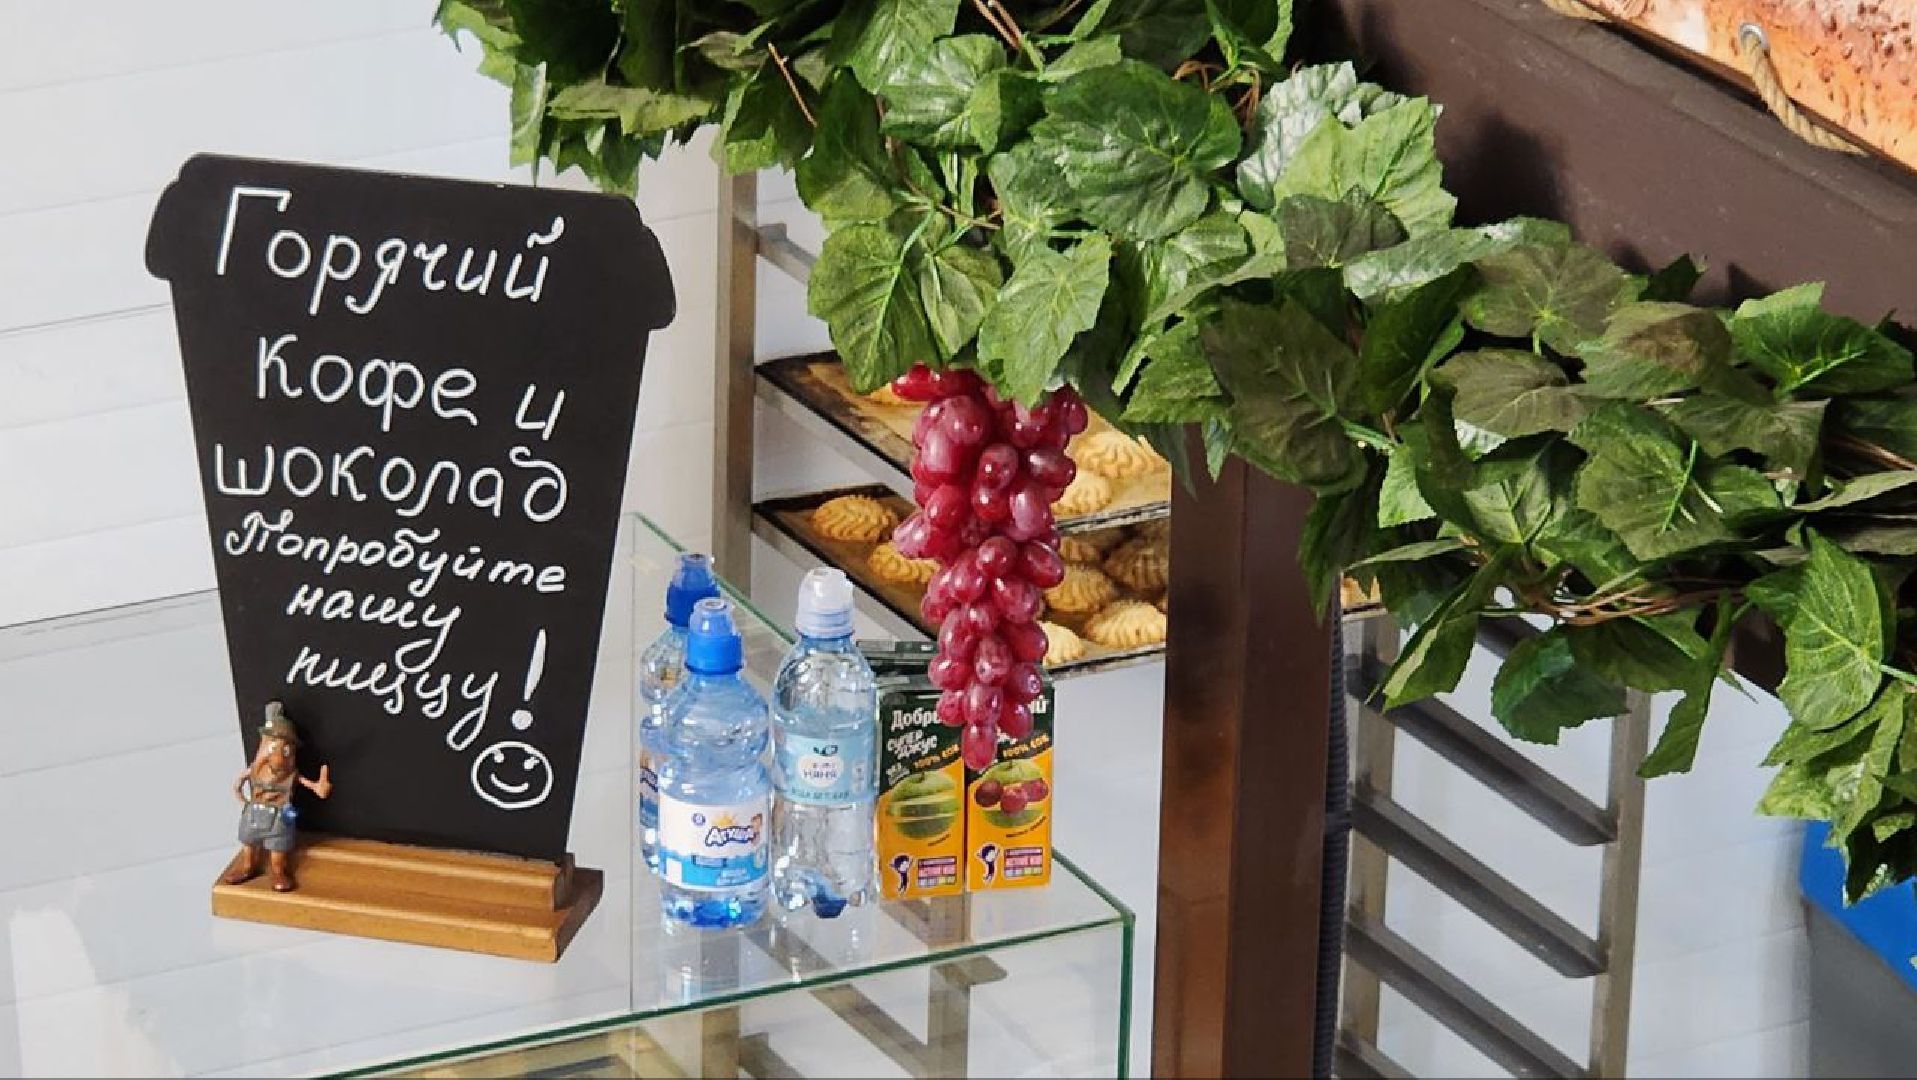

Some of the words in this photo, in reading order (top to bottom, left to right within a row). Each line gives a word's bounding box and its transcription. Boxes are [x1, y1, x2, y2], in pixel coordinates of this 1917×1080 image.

[217, 186, 564, 315] Горячий
[215, 444, 567, 522] шоколад
[223, 509, 567, 598] Попробуйте
[286, 584, 462, 673] нашу
[891, 706, 942, 731] Добр
